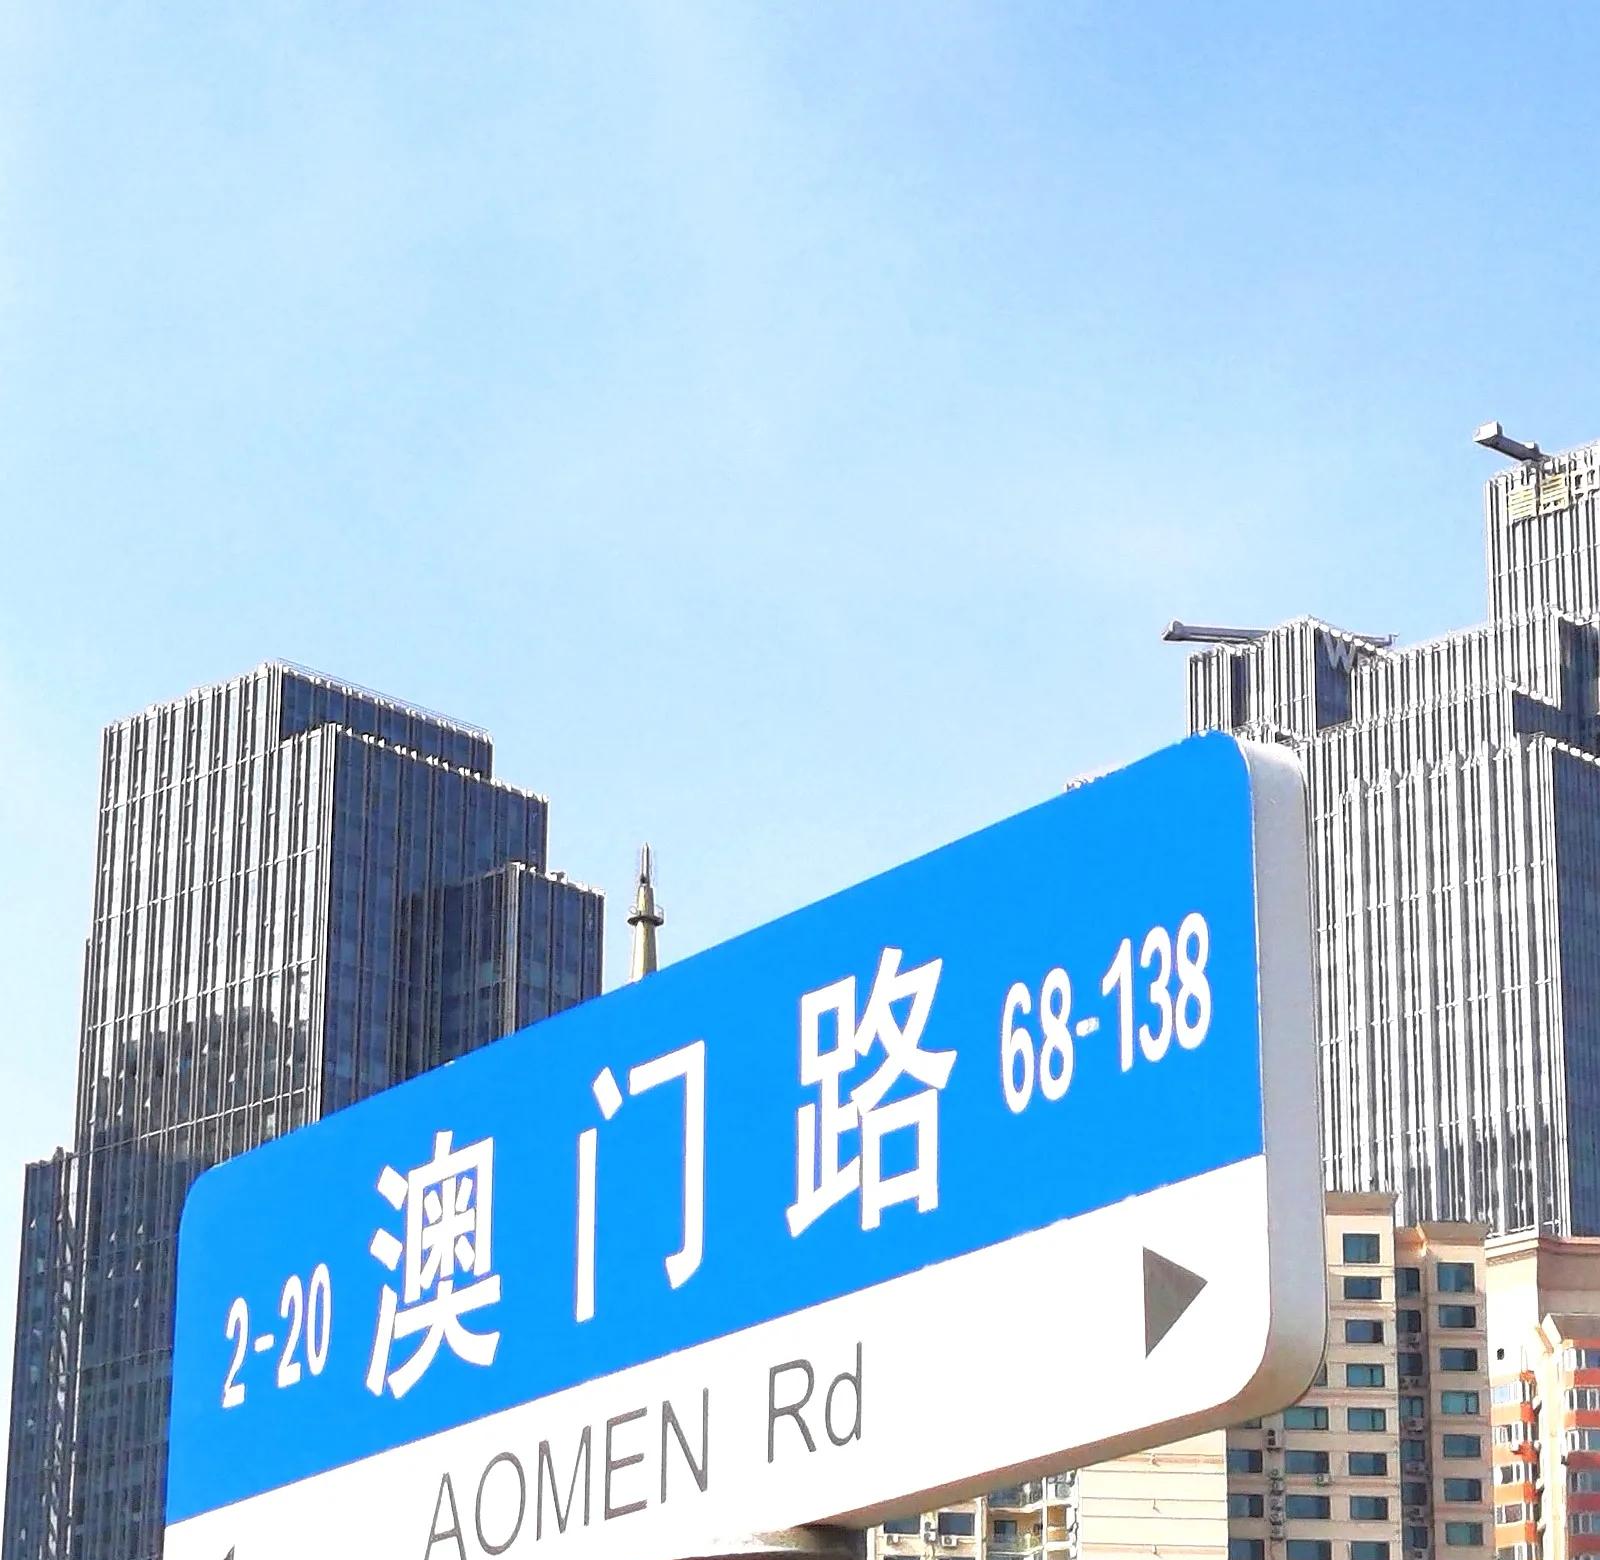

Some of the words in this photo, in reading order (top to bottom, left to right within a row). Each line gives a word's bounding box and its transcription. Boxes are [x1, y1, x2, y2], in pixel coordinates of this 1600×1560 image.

[222, 1263, 332, 1409] 2-20
[366, 947, 958, 1399] 澳门路
[1000, 912, 1212, 1115] 68-138
[767, 1341, 863, 1464] Rd
